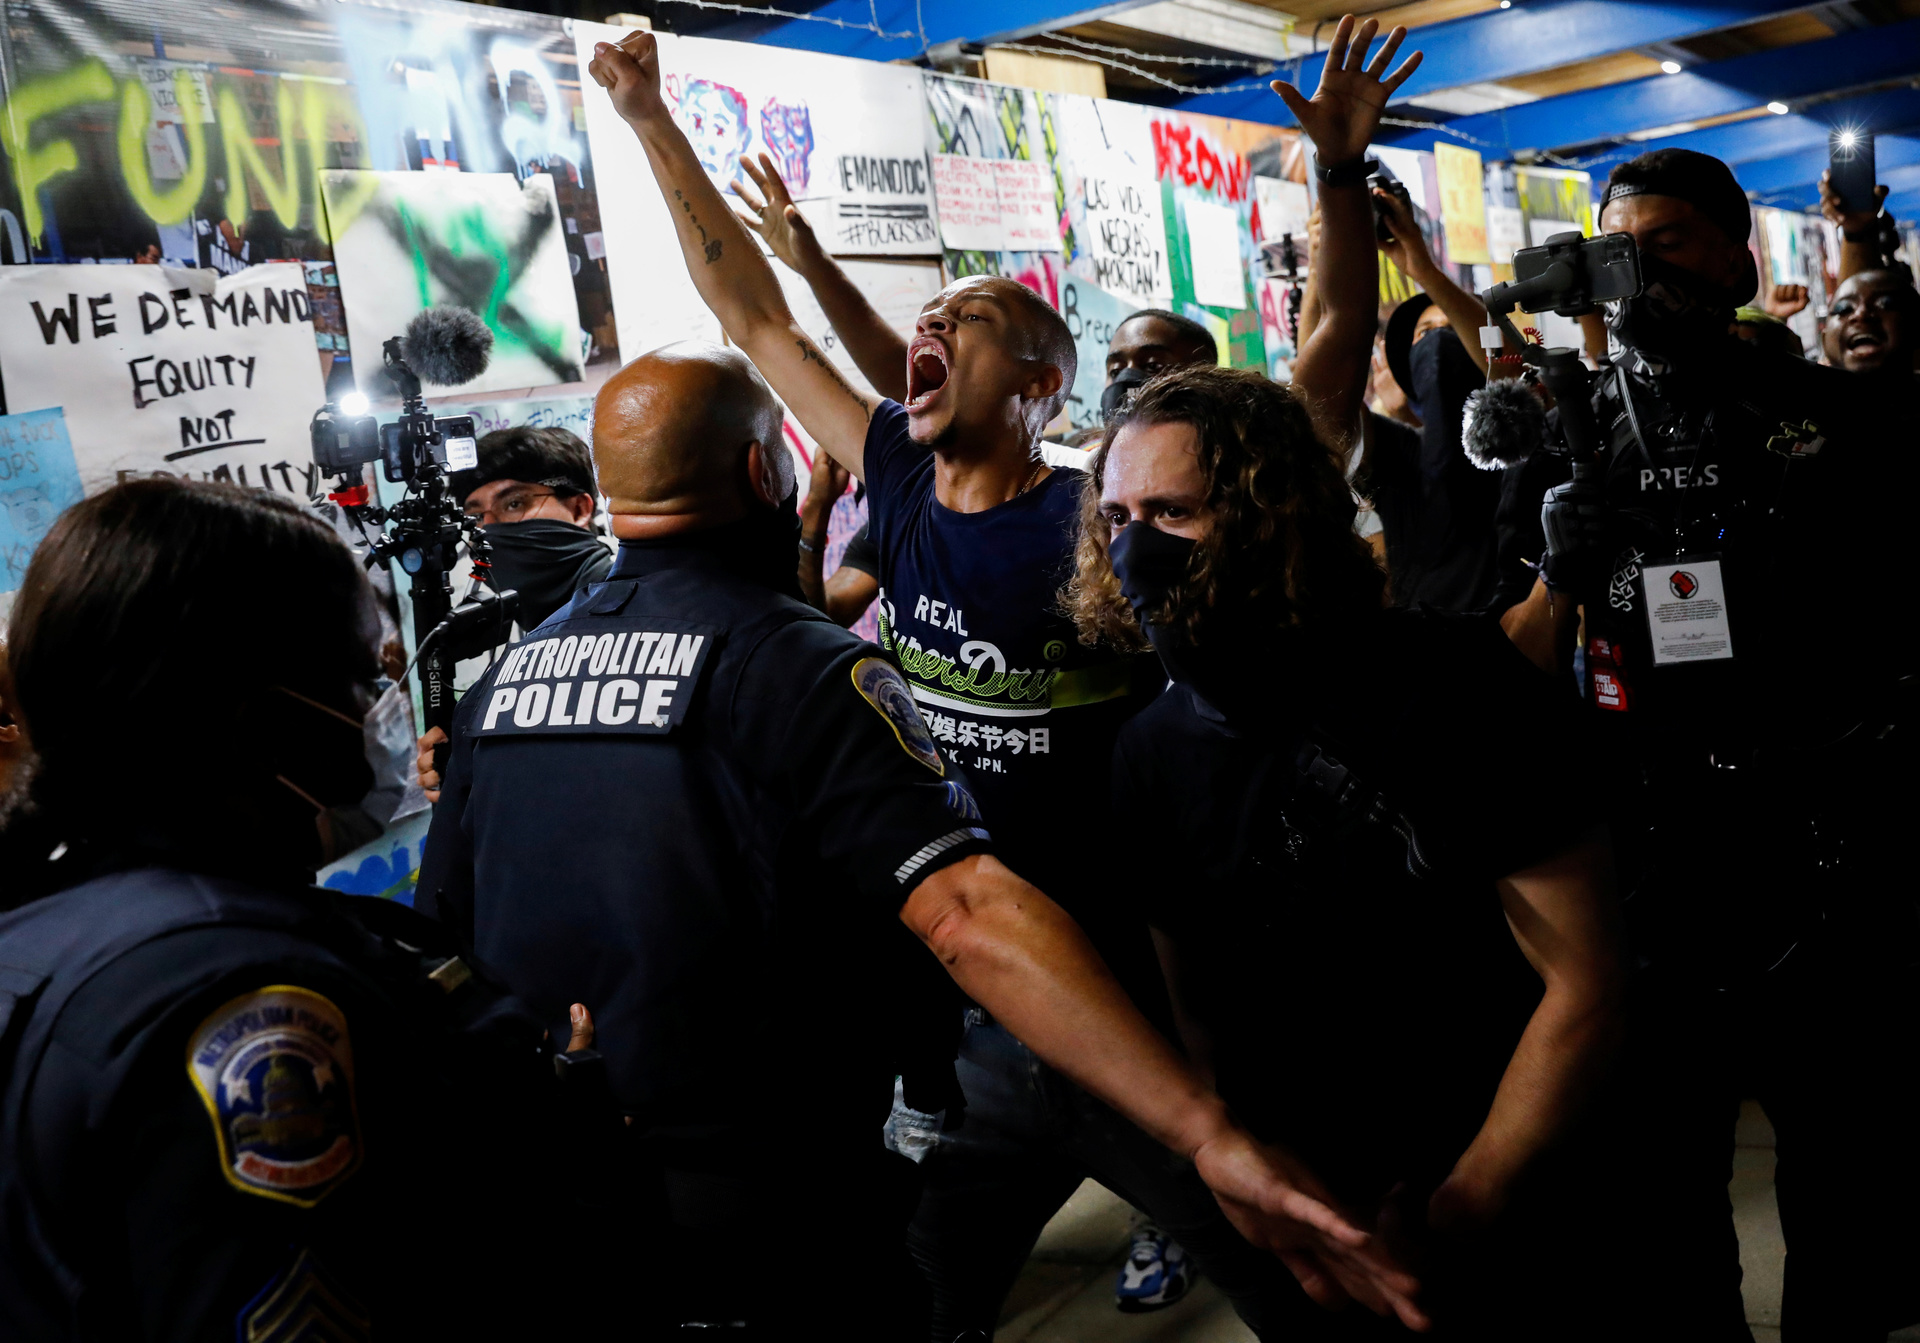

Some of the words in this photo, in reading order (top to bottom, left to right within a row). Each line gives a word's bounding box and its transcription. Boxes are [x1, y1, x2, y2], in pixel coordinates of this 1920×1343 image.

[30, 292, 118, 345] WE
[138, 287, 313, 335] DEMAND
[128, 355, 255, 409] EQUITY
[179, 408, 236, 447] NOT
[914, 594, 968, 637] REAL
[494, 632, 705, 686] METROPOLITAN
[429, 671, 441, 708] SIRUI
[482, 679, 678, 730] POLICE
[941, 747, 964, 765] K.
[973, 756, 1008, 774] JPN.
